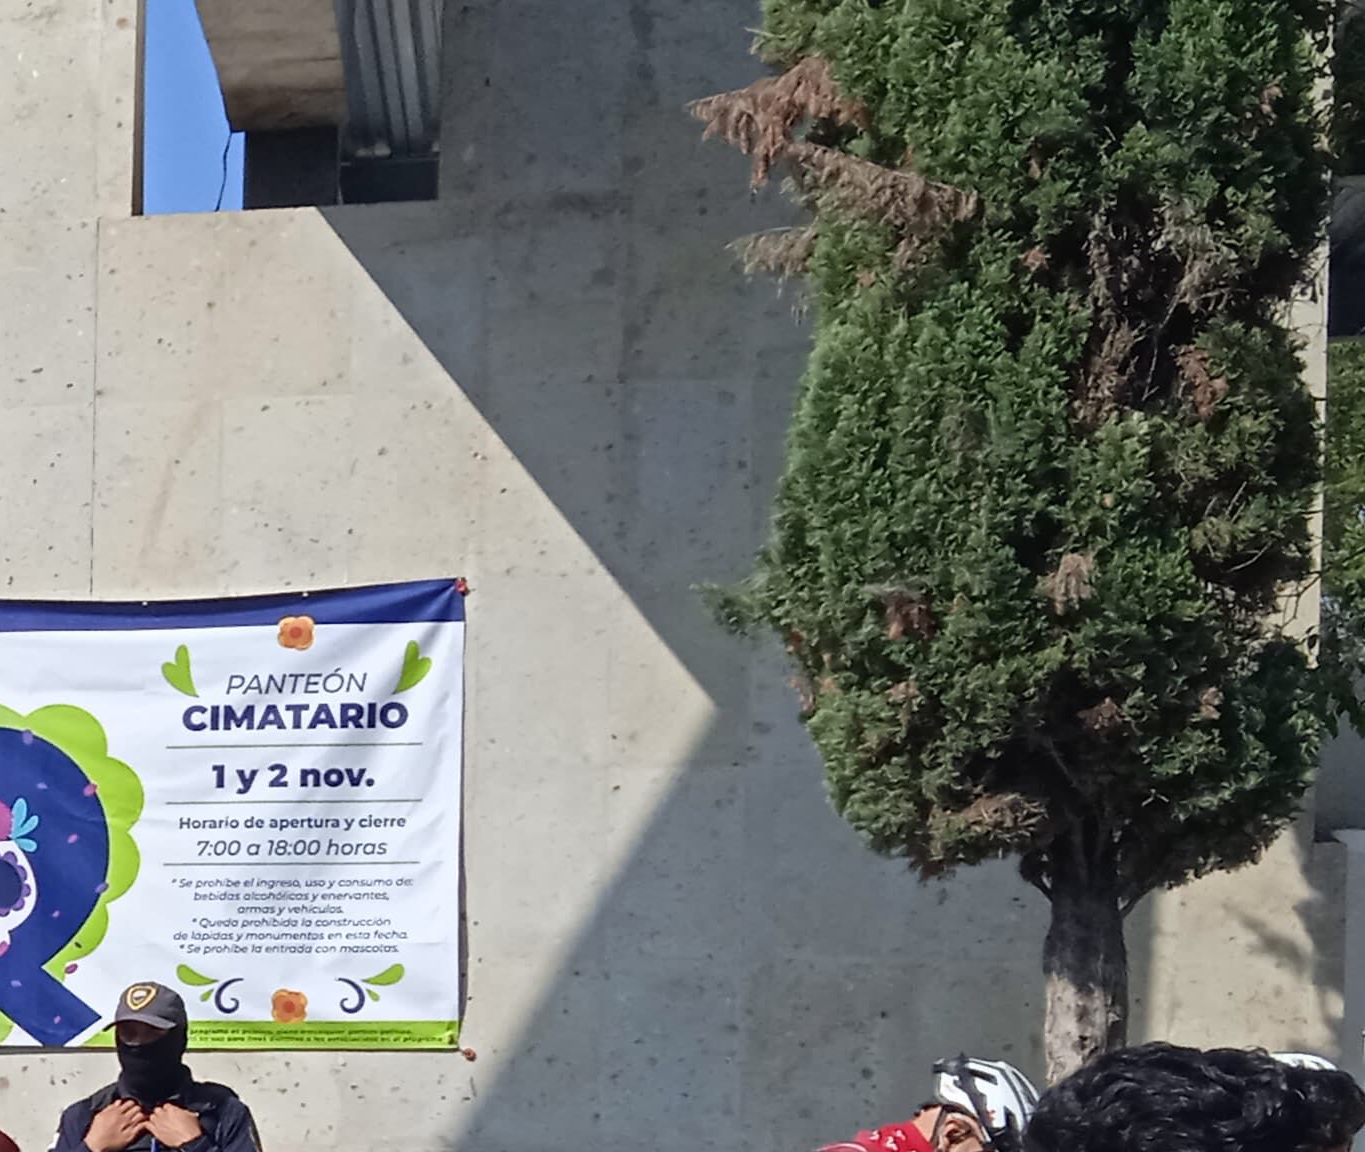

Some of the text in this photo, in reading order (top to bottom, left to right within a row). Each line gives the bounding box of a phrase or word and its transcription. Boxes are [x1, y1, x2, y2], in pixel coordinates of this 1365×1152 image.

[226, 667, 368, 695] PANTEÓN
[182, 702, 409, 732] CIMATARIO
[212, 763, 376, 795] 1 y 2 nov.
[179, 814, 407, 832] Horario de apertura y cierre
[197, 838, 388, 857] 7:00 a 18:00 horas
[178, 878, 193, 889] Se
[243, 877, 255, 888] el
[304, 879, 326, 888] uso
[327, 880, 336, 890] y
[338, 878, 393, 888] consumo
[194, 890, 390, 903] bebidas alcohólicas y enervantes,
[237, 905, 276, 914] armas
[276, 906, 286, 917] y
[199, 917, 391, 929] Queda prohibida la construcción
[173, 930, 189, 941] de
[235, 932, 244, 943] y
[246, 930, 325, 941] monumentos
[327, 932, 343, 940] en
[345, 931, 371, 940] esta
[186, 943, 201, 954] Se
[251, 943, 263, 954] la
[265, 943, 313, 954] entrada
[315, 944, 337, 954] con
[339, 943, 400, 953] mascotas.
